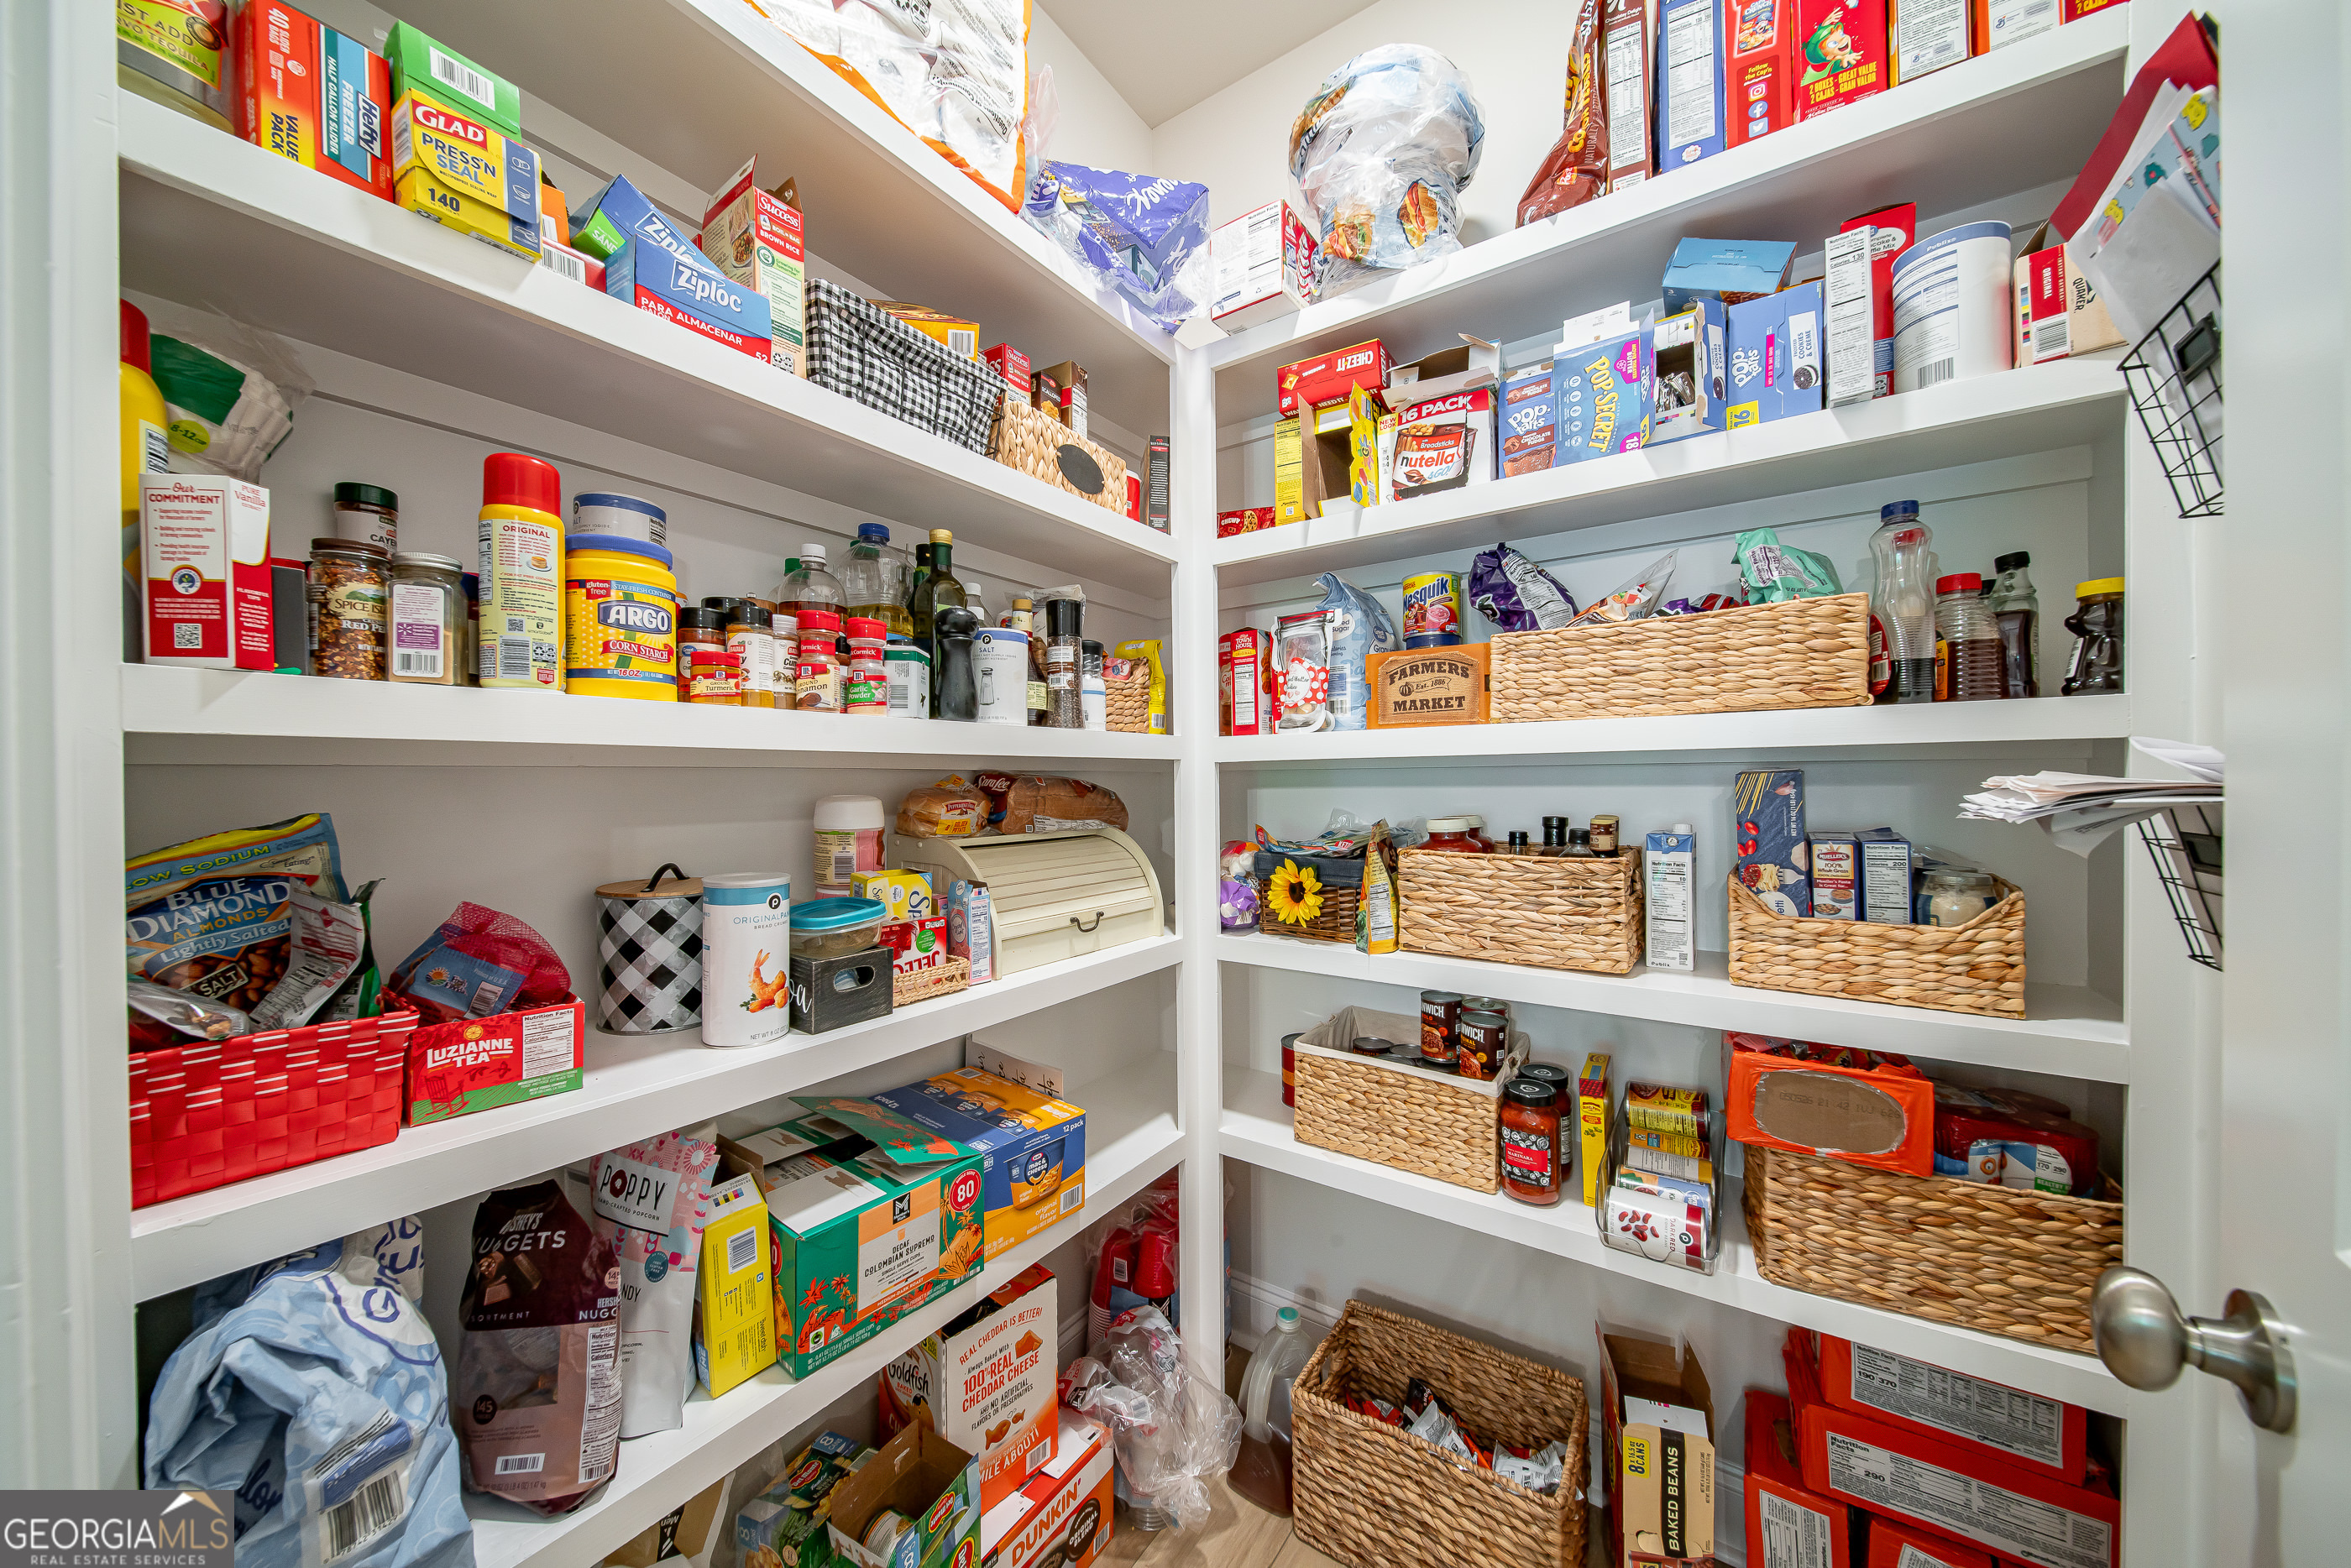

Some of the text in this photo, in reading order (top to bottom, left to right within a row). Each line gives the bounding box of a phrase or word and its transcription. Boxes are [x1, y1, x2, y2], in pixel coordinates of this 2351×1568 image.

[268, 8, 290, 29] 40
[154, 20, 194, 46] ADD
[149, 31, 209, 72] TEQUILA
[1748, 62, 1768, 74] Follow
[1756, 67, 1772, 76] Cap'n
[1814, 61, 1877, 93] BOXES GREAT VALUE
[1815, 72, 1877, 102] CAJAS GRAN VALOR
[327, 55, 339, 155] HALF SLIDER
[342, 79, 354, 146] FREEZER
[271, 112, 285, 154] PACK
[359, 99, 379, 152] Hefty
[415, 106, 484, 143] GLAD
[285, 114, 299, 162] VALUE
[422, 132, 496, 178] PRESS'N
[436, 154, 484, 186] SEAL
[428, 187, 460, 212] 140
[759, 196, 799, 227] Success
[760, 229, 800, 256] BROWN RICE
[1829, 229, 1865, 244] Nutrition Facts
[1830, 252, 1865, 269] Calories 130
[678, 265, 742, 313] Ziploc
[2042, 267, 2053, 300] ORIGINAL
[2072, 277, 2087, 311] QUAKER
[641, 296, 743, 346] PARA ALMACENAR
[1804, 329, 1813, 351] CREME
[1007, 349, 1029, 368] Success
[1337, 350, 1374, 372] CHEEZ-IT
[1041, 386, 1061, 403] SCALLOPED
[1318, 398, 1335, 407] NEED
[1399, 394, 1473, 425] 16 PACK
[1380, 417, 1396, 426] NEW
[1380, 422, 1396, 431] LOOK
[1733, 410, 1751, 429] 16
[1420, 438, 1455, 450] Breadsticks
[1521, 431, 1552, 443] CHOCOLATE
[1527, 436, 1545, 447] FUDGE
[1400, 451, 1455, 468] nutella
[172, 482, 195, 493] Our
[241, 484, 260, 497] PURE
[149, 494, 221, 504] COMMITMENT
[235, 490, 266, 508] Vanilla
[1221, 516, 1242, 526] CHEWY
[502, 525, 551, 540] ORIGINAL
[590, 587, 607, 596] free
[613, 583, 648, 594] STAY-FRESH
[335, 598, 369, 613] SPICE
[341, 619, 369, 631] RED
[608, 605, 669, 631] ARGO
[609, 639, 669, 660] CORN STARCH
[729, 645, 745, 654] BADIA
[1234, 641, 1254, 651] HOUSE
[798, 678, 819, 688] GROUND
[1388, 661, 1470, 686] FARMERS
[849, 685, 869, 694] Garlic
[1414, 678, 1447, 691] Est. 1886
[847, 691, 872, 701] Powder
[1392, 695, 1466, 713] MARKET
[180, 845, 270, 875] SODIUM
[1819, 852, 1848, 860] MUELLER'S
[1824, 861, 1843, 870] 100%
[166, 877, 251, 911] BLUE
[127, 881, 291, 943] DIAMOND
[173, 907, 270, 943] ALMONDS
[160, 917, 291, 964] Lightly Salted
[199, 970, 238, 996] SALT
[524, 1009, 574, 1022] Nutrition Facts
[524, 1034, 549, 1043] Calories
[427, 1037, 516, 1069] LUZIANNE
[453, 1053, 490, 1068] TEA
[1062, 1119, 1085, 1133] 12 pack
[1029, 1160, 1041, 1170] mac
[1508, 1150, 1533, 1162] MARINARA
[956, 1179, 975, 1203] 80
[1018, 1189, 1033, 1199] original
[597, 1197, 661, 1221] HAND-CRAFTED POPCORN
[1035, 1199, 1058, 1217] original
[1039, 1207, 1058, 1221] flavor
[864, 1234, 935, 1278] COLOMBIAN SUPREMO
[892, 1239, 910, 1254] DECAF
[882, 1252, 921, 1277] SINGLE SERVE CUPS
[877, 1285, 909, 1306] MEDIUM-DARK
[959, 1306, 1044, 1367] REAL CHEDDAR IS BETTER!
[967, 1343, 1010, 1374] Always With
[1856, 1345, 1880, 1356] Nutrition
[990, 1351, 1014, 1378] REAL
[888, 1361, 929, 1395] Goldfish
[962, 1350, 1040, 1414] CHEDDAR CHEESE
[1856, 1370, 1898, 1388] 190 370
[897, 1382, 913, 1394] BAKED
[979, 1377, 1029, 1416] AND NO ARTIFICIAL
[476, 1400, 494, 1414] 145
[971, 1382, 1034, 1431] FLAVORS OR PRESERVATIVES
[1636, 1441, 1646, 1465] CANS
[1830, 1435, 1870, 1452] Nutrition
[1830, 1442, 1855, 1453] Facts
[793, 1461, 819, 1487] Del Monte
[1864, 1470, 1886, 1483] 290
[946, 1497, 955, 1508] Del
[1666, 1446, 1680, 1552] BAKED BEANS
[1068, 1511, 1099, 1545] ORIGINAL
[1073, 1522, 1094, 1548] BLEND
